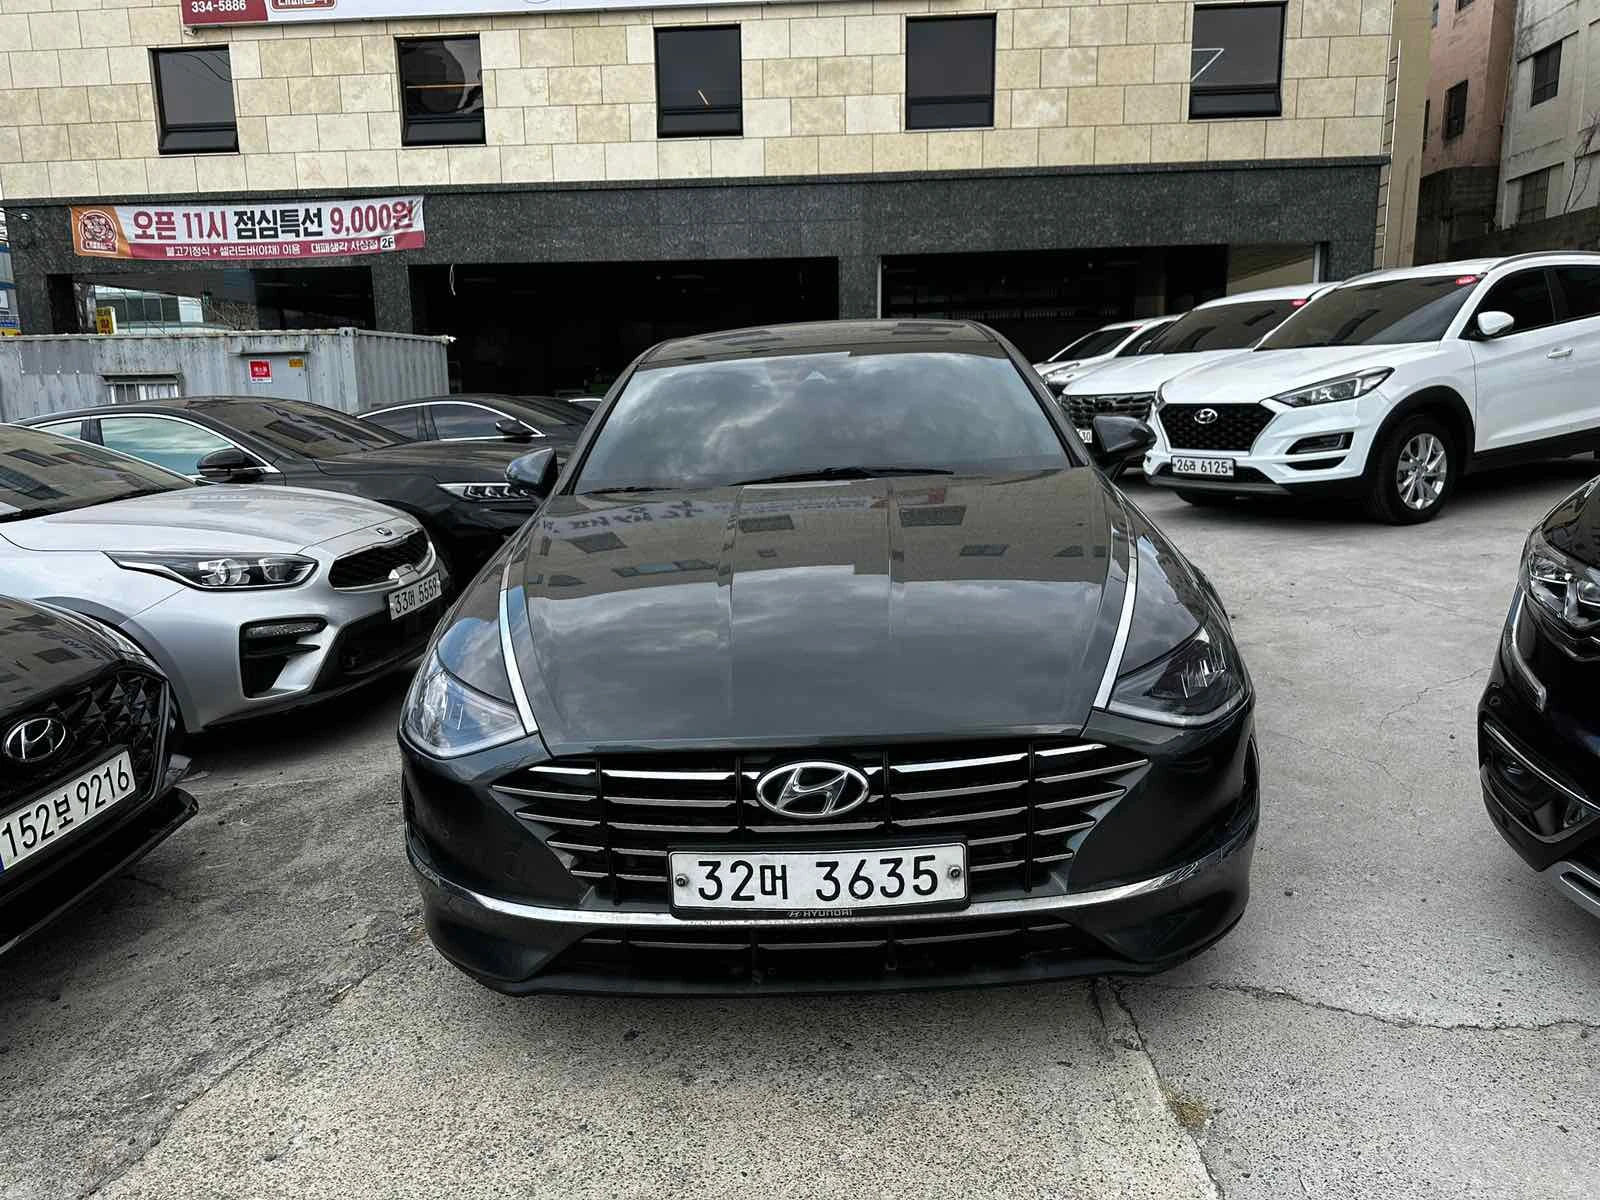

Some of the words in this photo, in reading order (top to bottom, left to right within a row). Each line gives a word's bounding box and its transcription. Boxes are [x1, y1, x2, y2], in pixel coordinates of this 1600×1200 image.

[192, 0, 247, 13] 334-5886
[133, 211, 176, 240] 오픈
[182, 210, 229, 241] 11시
[235, 208, 323, 239] 점심특선
[329, 200, 415, 237] 9,000원
[165, 246, 210, 257] 불고기정식
[282, 243, 301, 256] 이용
[311, 241, 348, 255] 대패생각
[351, 239, 378, 251] 사상점
[382, 237, 394, 249] 2F
[1200, 460, 1228, 474] 6125
[418, 577, 437, 602] 5559
[2, 794, 73, 857] 152보
[76, 760, 129, 816] 9216
[698, 860, 788, 902] 32머
[815, 855, 938, 901] 3635
[803, 909, 852, 917] HYUNDAI
